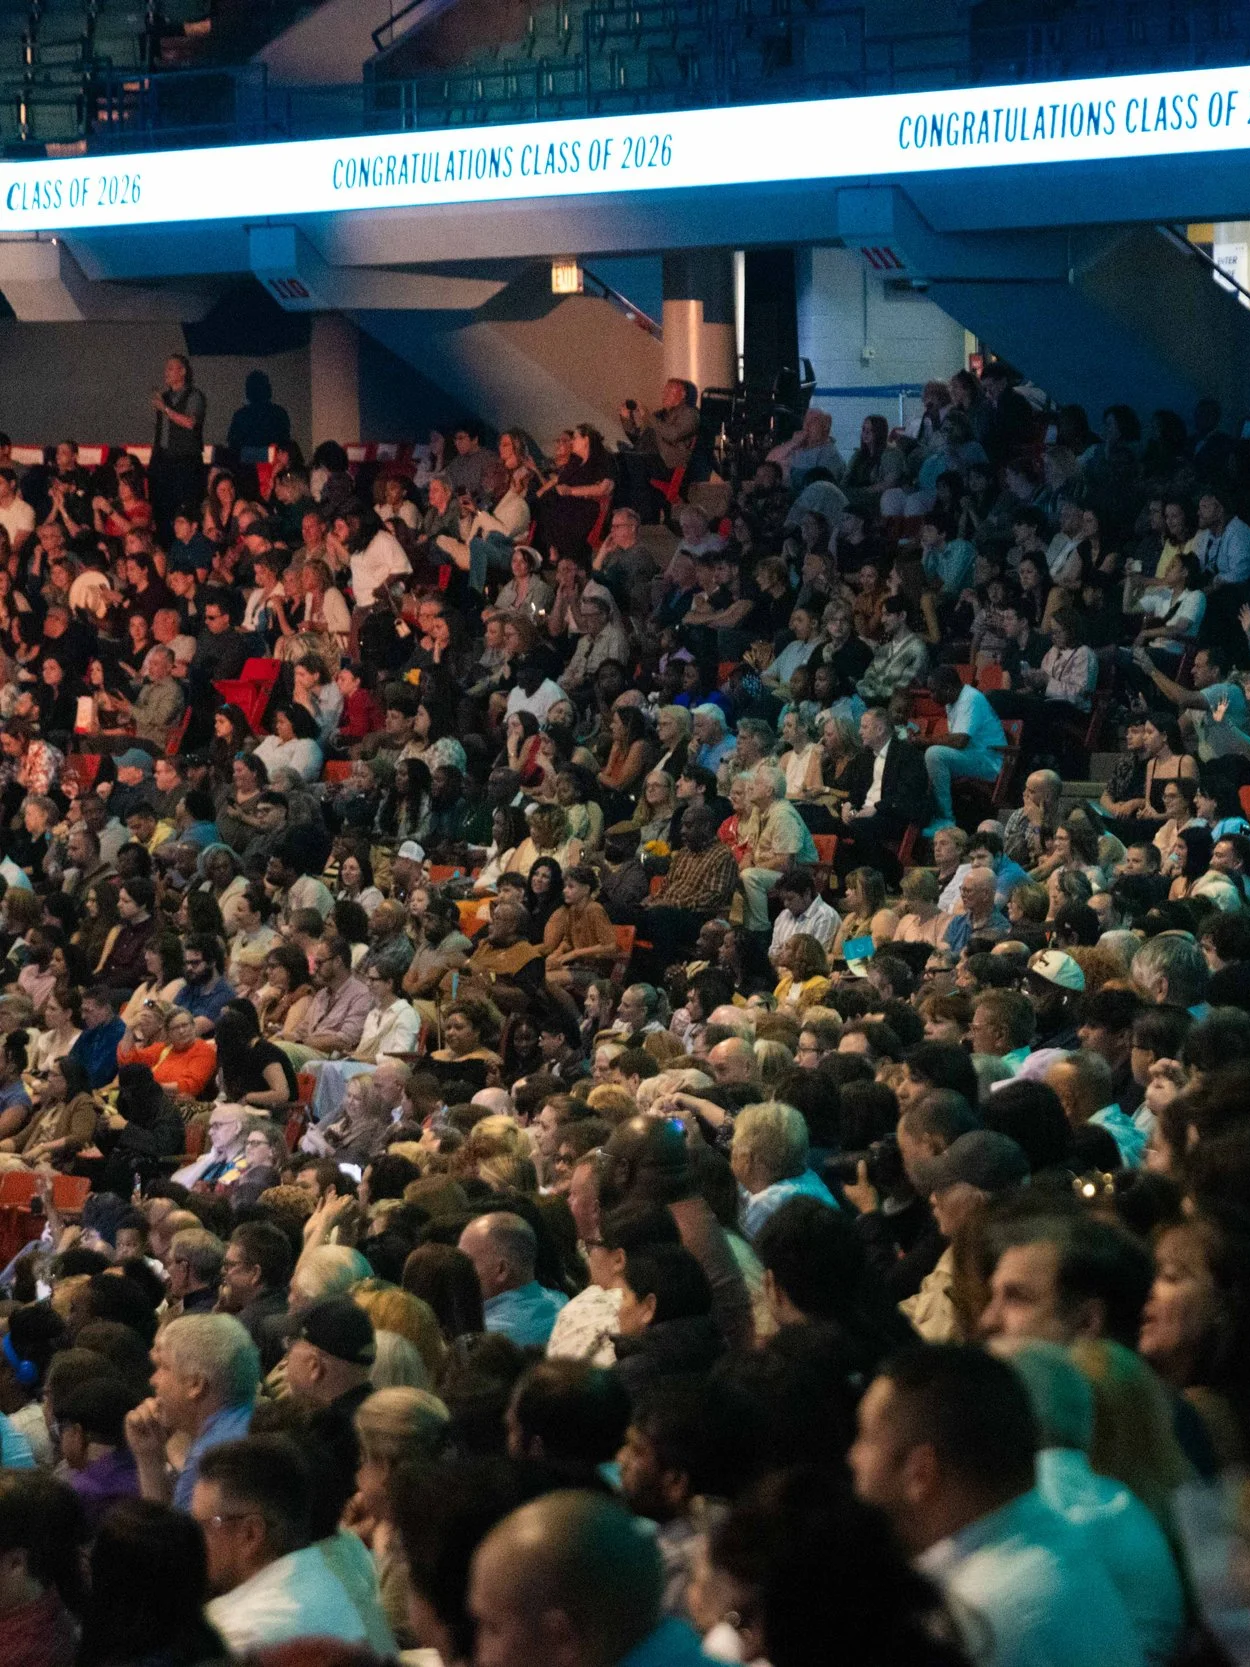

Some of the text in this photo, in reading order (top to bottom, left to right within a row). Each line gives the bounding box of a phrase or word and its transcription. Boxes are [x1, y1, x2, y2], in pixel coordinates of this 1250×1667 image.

[898, 98, 1116, 149] CONGRATULATIONS
[1125, 92, 1199, 134] CLASS
[1207, 89, 1238, 127] OF
[332, 134, 673, 189] CONGRATULATIONS CLASS OF 2026
[6, 173, 142, 211] CLASS OF 2026
[555, 264, 574, 288] EXIT
[861, 246, 905, 270] 111
